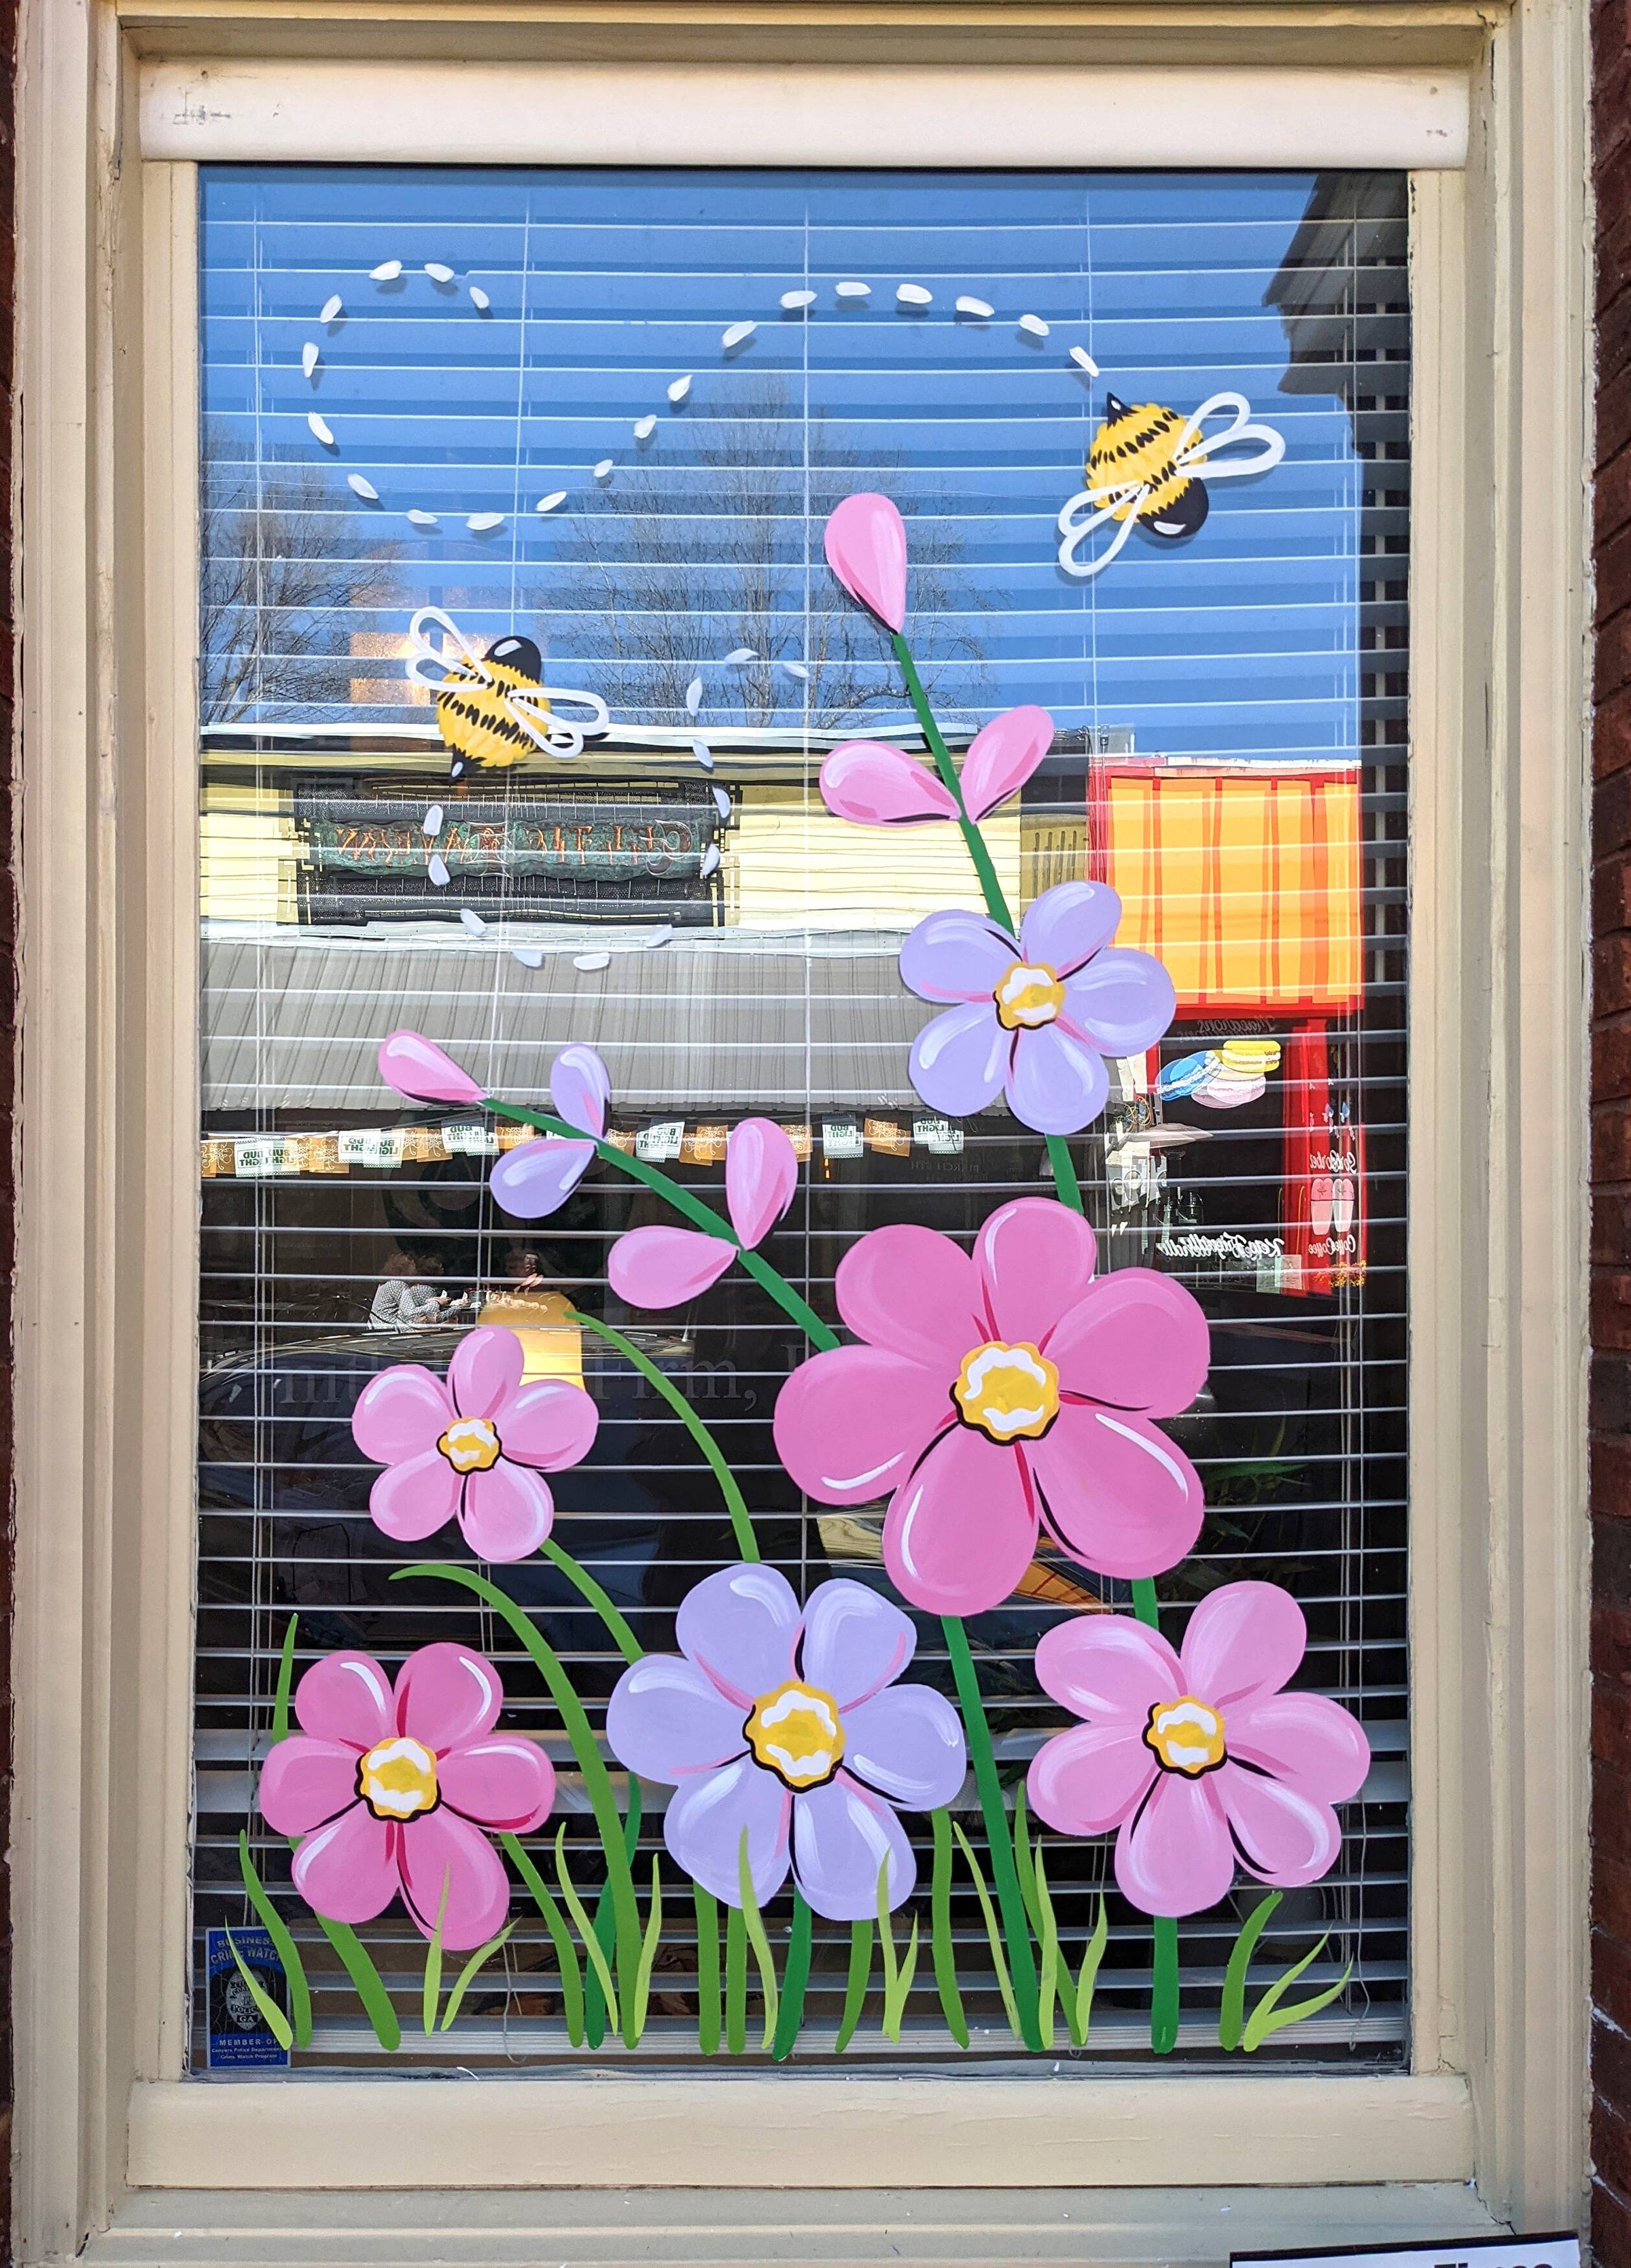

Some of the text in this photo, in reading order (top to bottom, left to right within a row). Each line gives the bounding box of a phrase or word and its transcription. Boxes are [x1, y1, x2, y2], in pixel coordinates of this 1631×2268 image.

[217, 1936, 272, 1949] BSINES
[247, 1947, 279, 1961] WATC
[232, 2004, 259, 2014] POLIC
